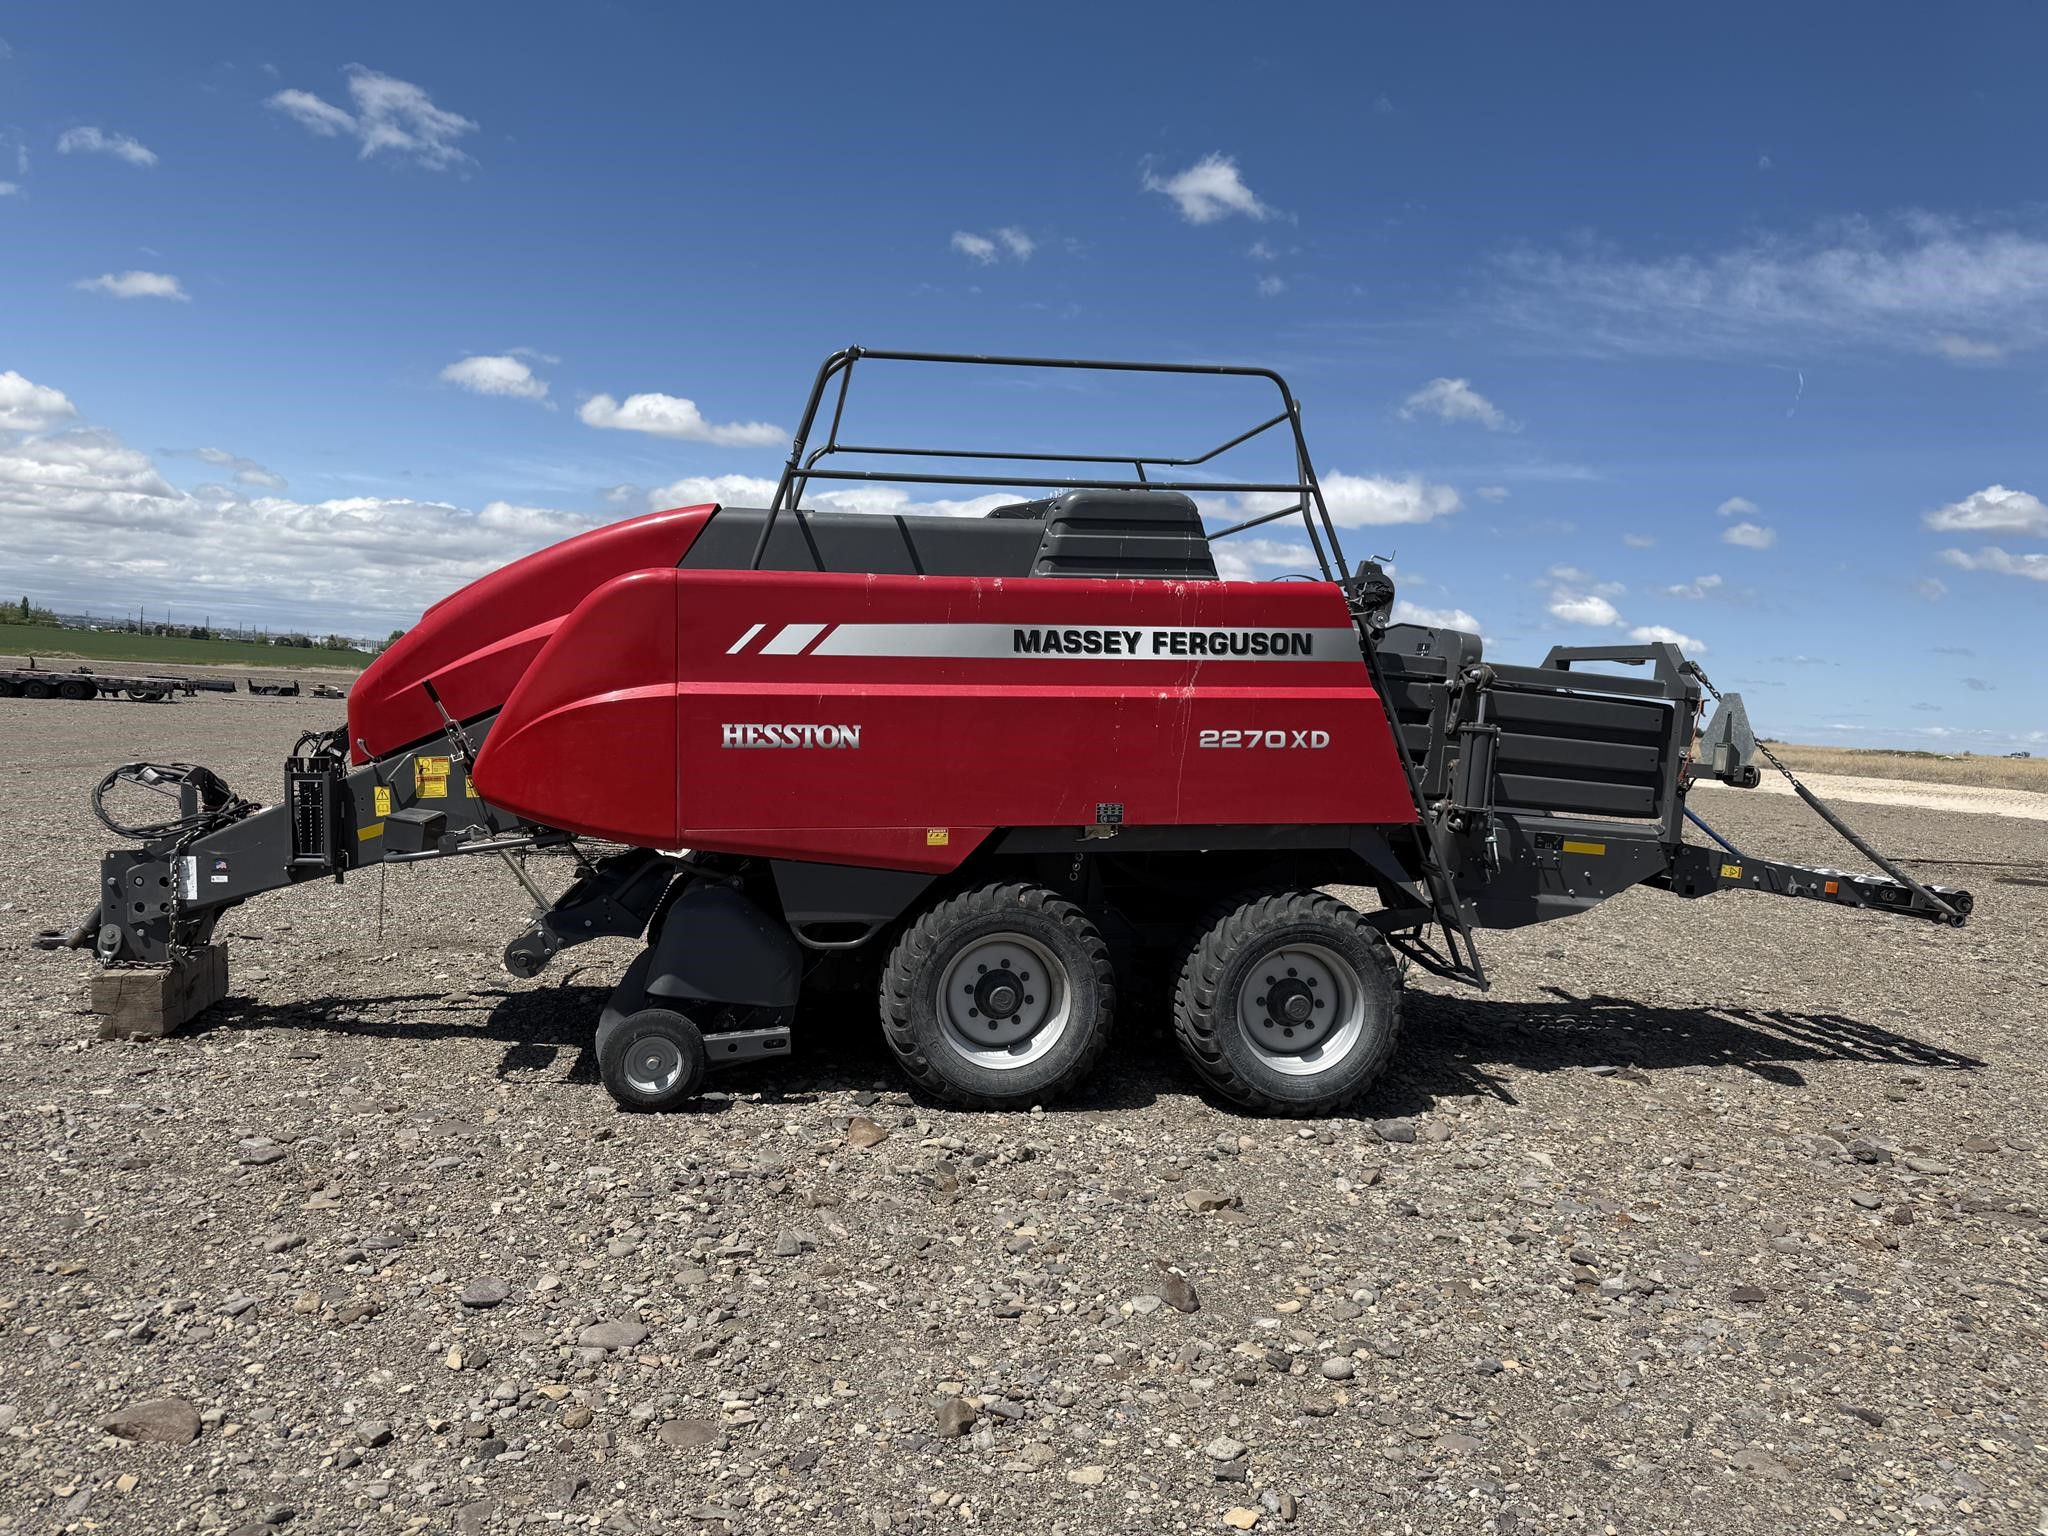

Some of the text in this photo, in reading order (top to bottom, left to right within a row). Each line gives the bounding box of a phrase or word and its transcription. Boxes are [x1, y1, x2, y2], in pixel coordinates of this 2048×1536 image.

[1013, 629, 1312, 656] MASSEY FERGUSON
[721, 723, 861, 749] HESSTON
[1199, 729, 1330, 748] 2270XD
